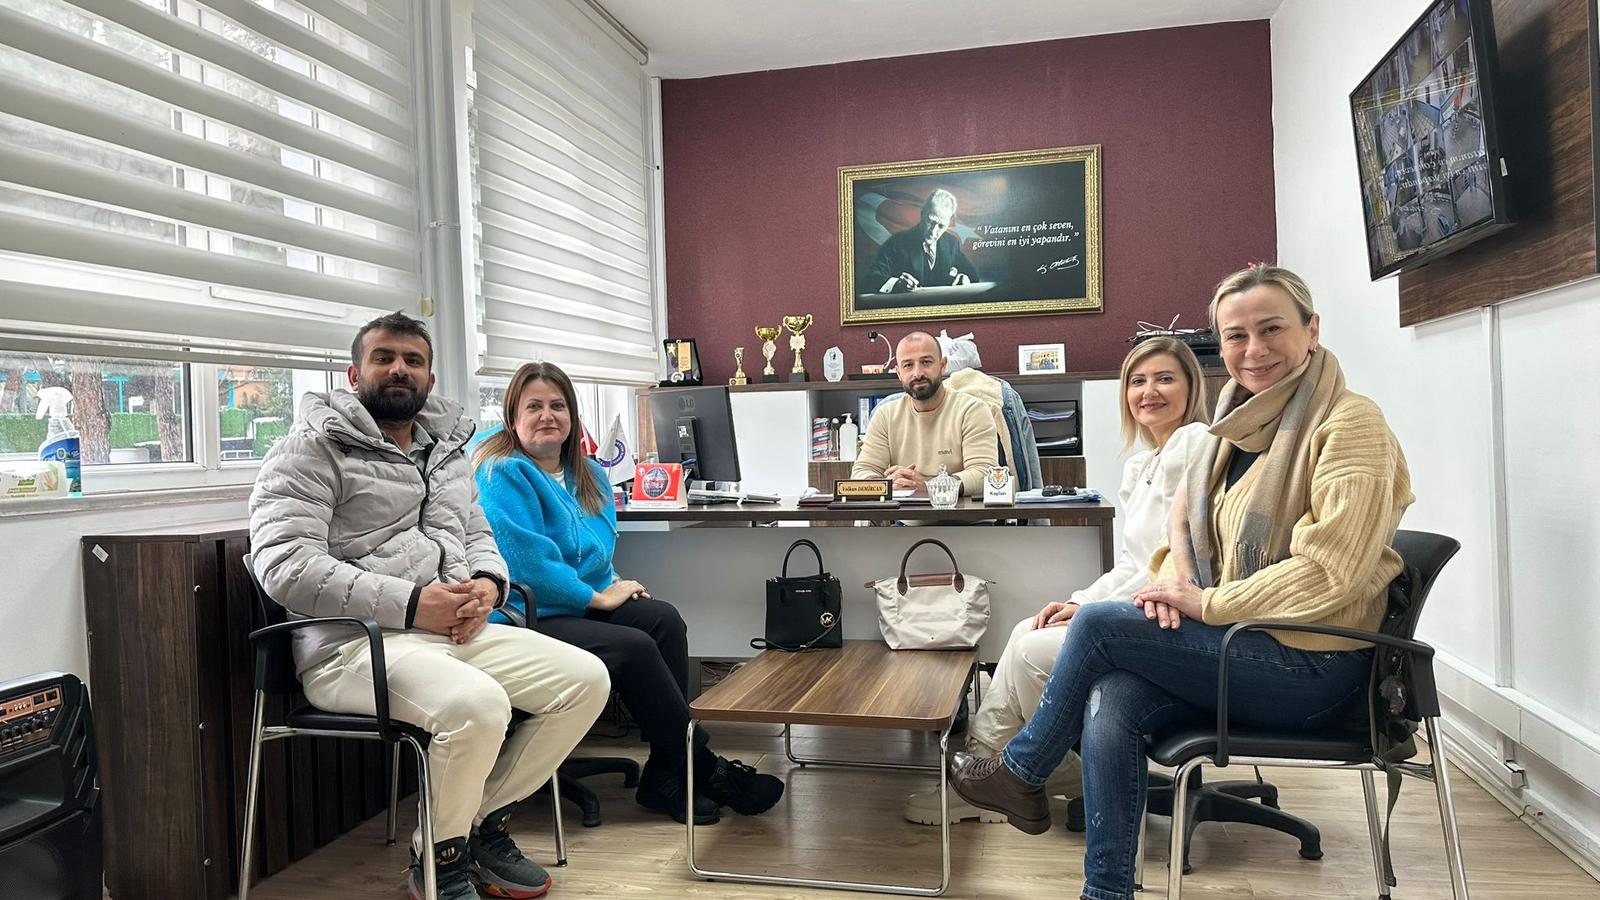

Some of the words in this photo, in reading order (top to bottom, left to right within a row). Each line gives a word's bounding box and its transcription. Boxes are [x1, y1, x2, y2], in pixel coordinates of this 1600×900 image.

[984, 225, 1019, 235] Vatanını
[1033, 221, 1047, 233] çok
[1049, 221, 1074, 230] seven,
[972, 237, 1006, 250] görevini
[1019, 235, 1030, 247] iyi
[1030, 233, 1071, 247] yapandır.
